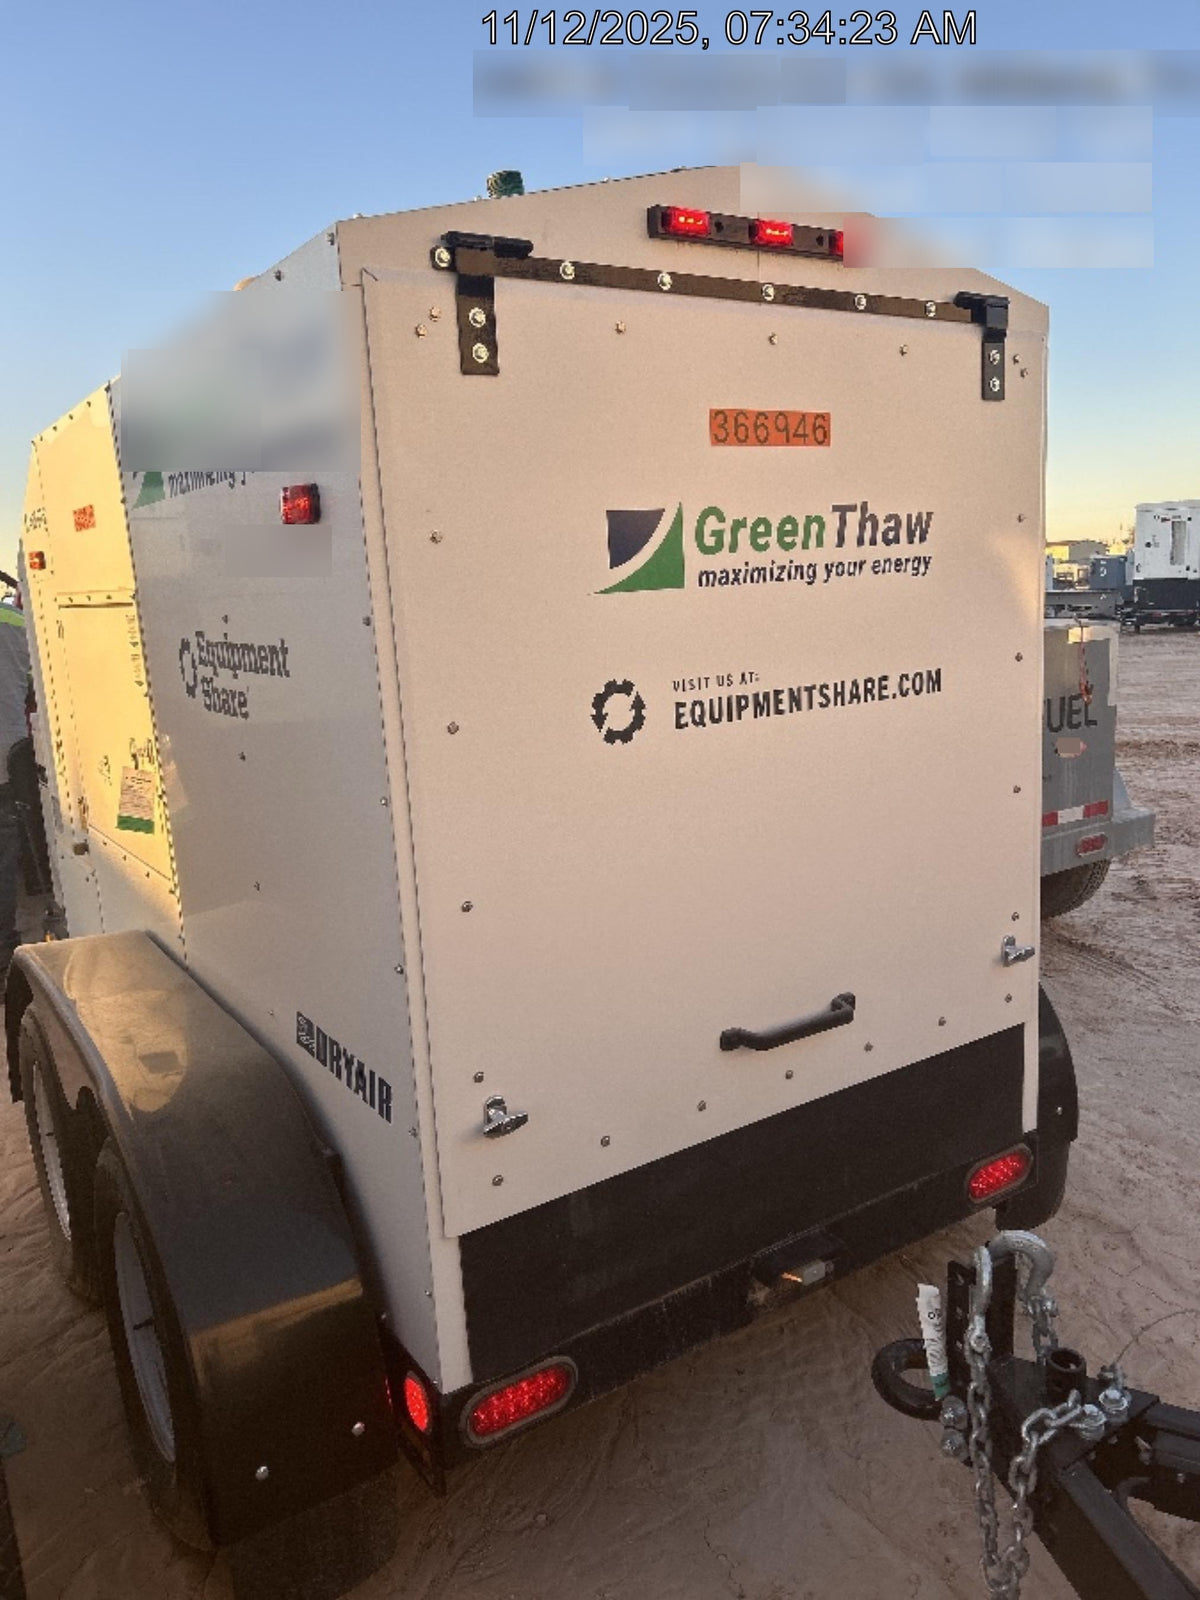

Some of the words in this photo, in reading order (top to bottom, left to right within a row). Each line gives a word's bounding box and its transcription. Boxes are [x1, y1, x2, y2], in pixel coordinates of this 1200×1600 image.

[713, 409, 828, 445] 366946
[695, 501, 933, 555] GreenThaw
[698, 560, 816, 587] maximizing
[823, 558, 866, 583] your
[871, 554, 932, 577] energy
[195, 630, 290, 679] Equipment
[200, 675, 249, 720] Share
[672, 676, 711, 692] VISIT
[716, 674, 734, 687] US
[738, 671, 760, 686] AT:
[674, 668, 942, 730] EQUIPMENTSHARE.COM
[1043, 691, 1098, 733] UEL
[316, 1025, 392, 1124] DRYAIR
